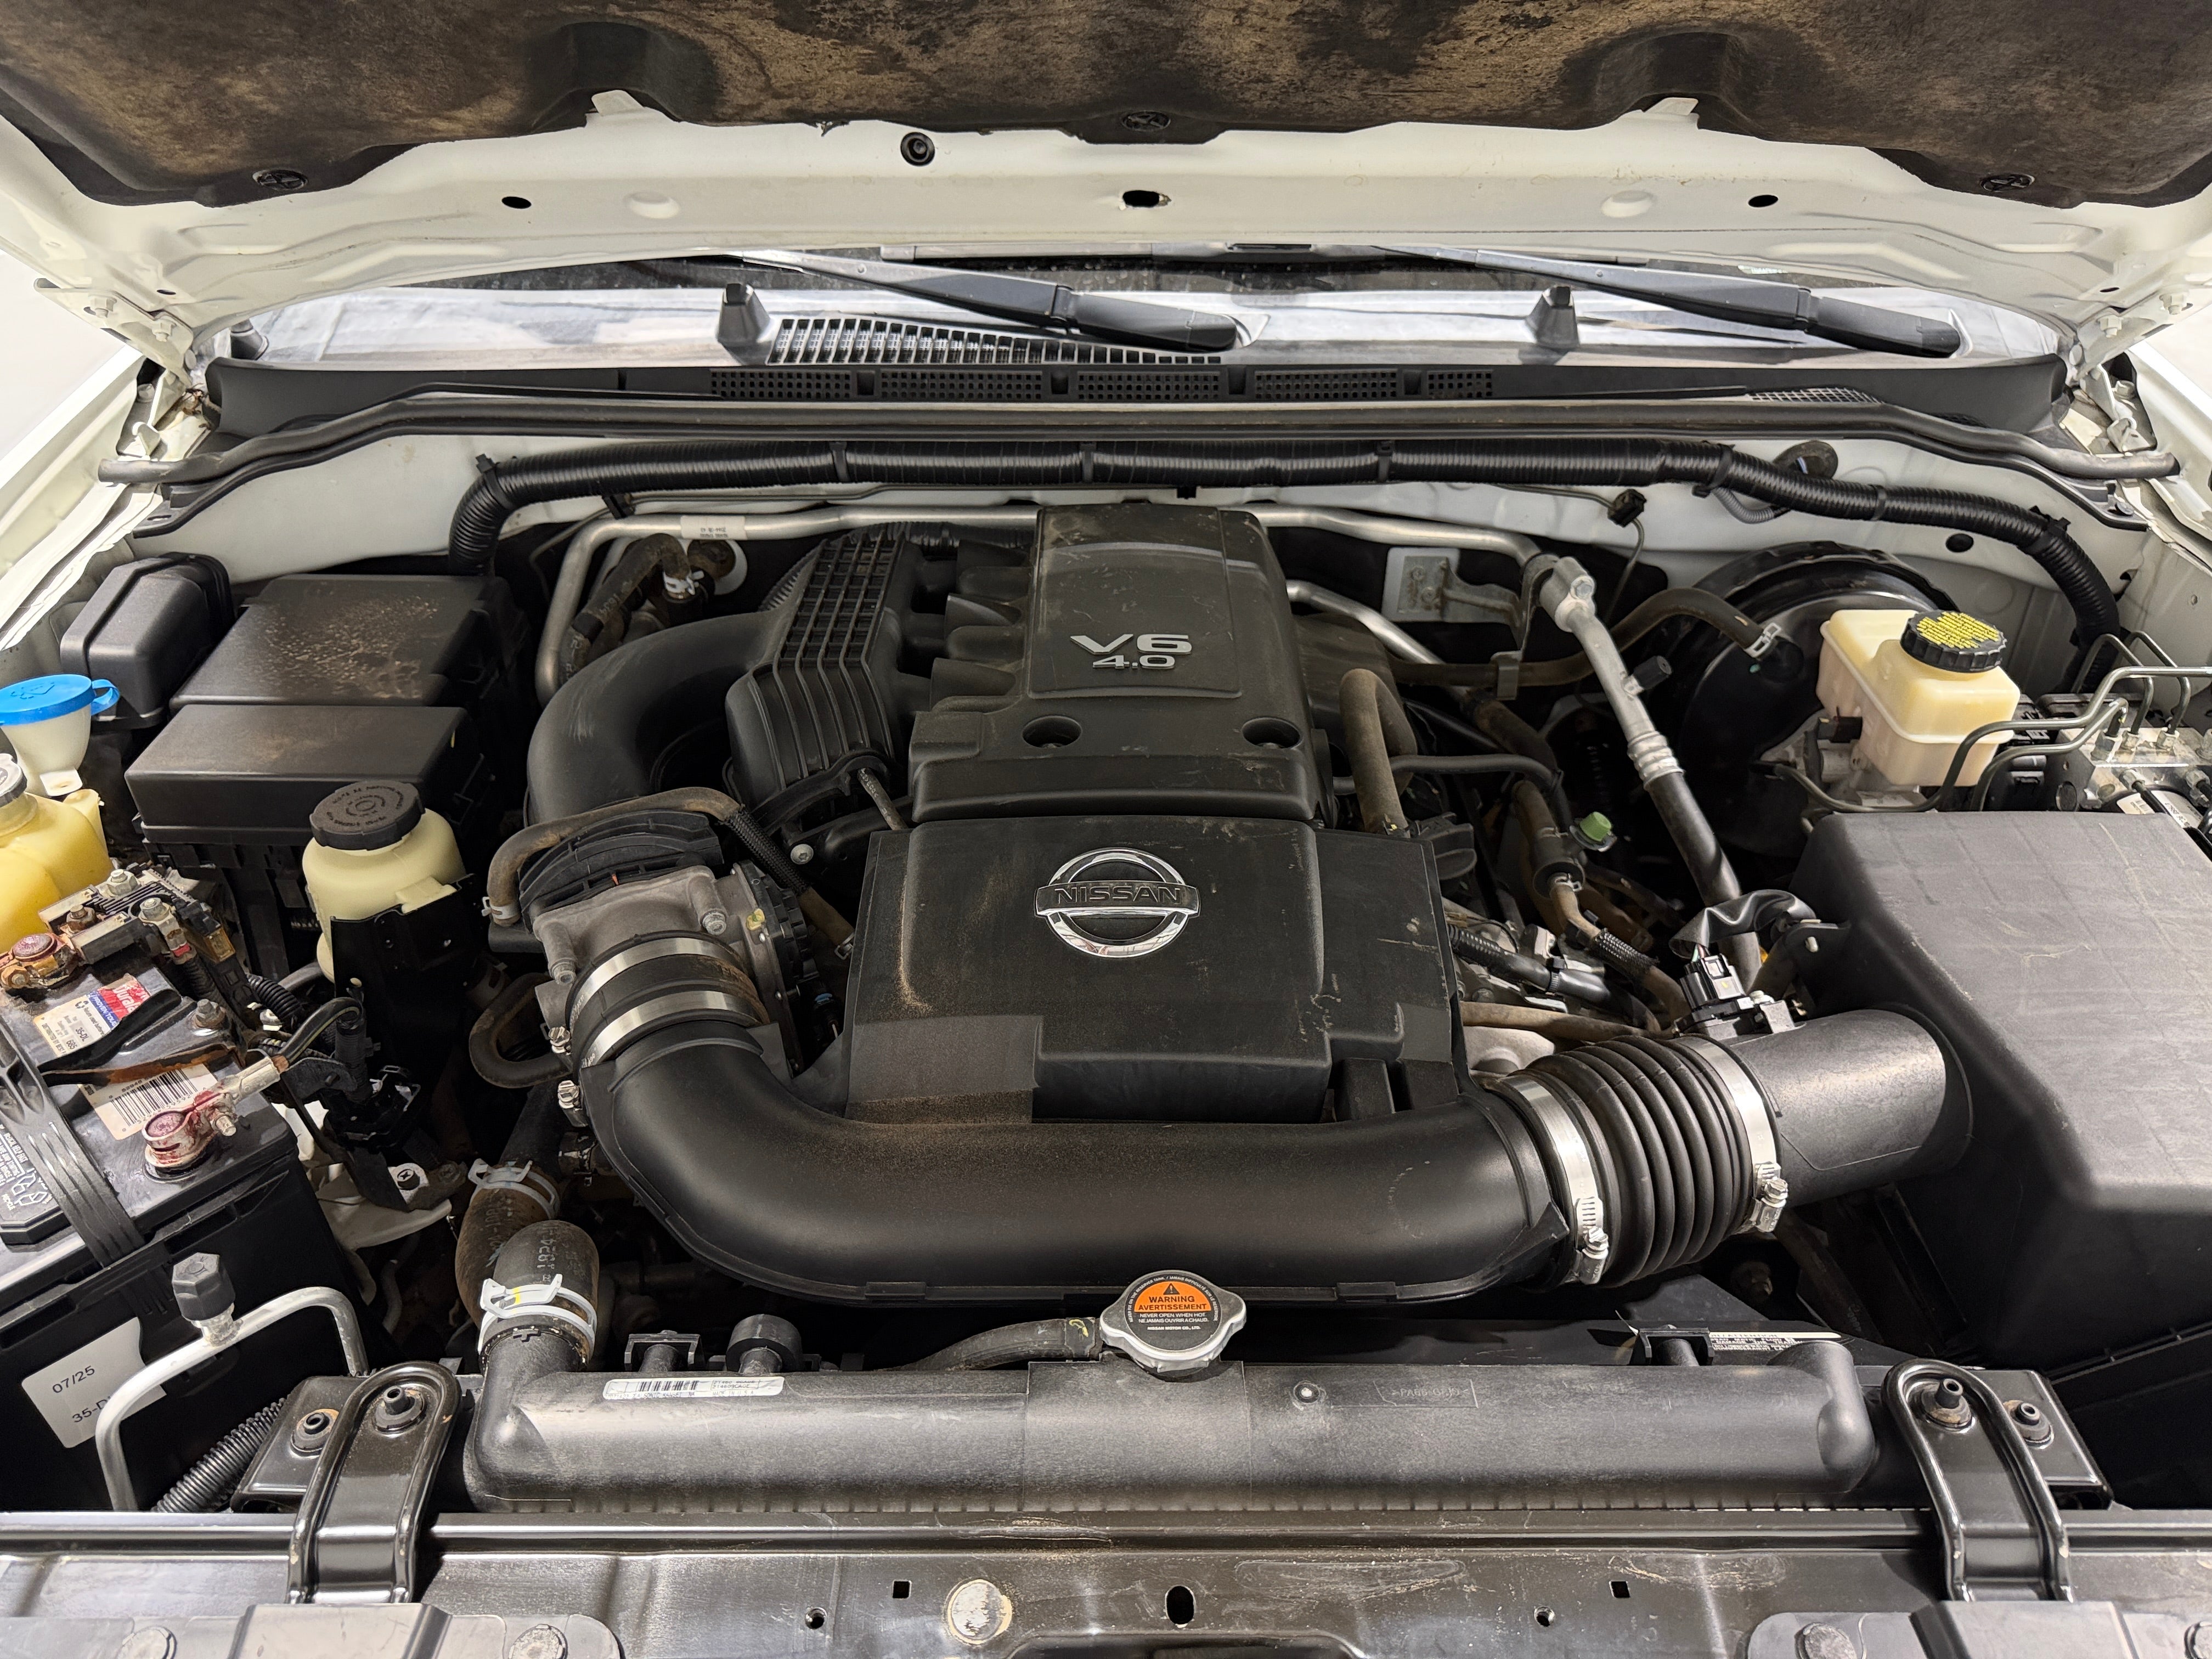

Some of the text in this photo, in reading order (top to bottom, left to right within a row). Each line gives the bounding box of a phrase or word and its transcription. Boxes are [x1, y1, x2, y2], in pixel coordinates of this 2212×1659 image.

[1070, 634, 1193, 655] V6
[1092, 655, 1176, 669] 4.0
[1054, 885, 1181, 905] NISSAN
[93, 996, 108, 1015] PROVEN
[112, 984, 138, 1013] Durala
[66, 1039, 78, 1050] 685
[75, 1027, 89, 1042] 35-DL
[52, 1365, 95, 1393] 07/25
[72, 1396, 111, 1423] 35-D
